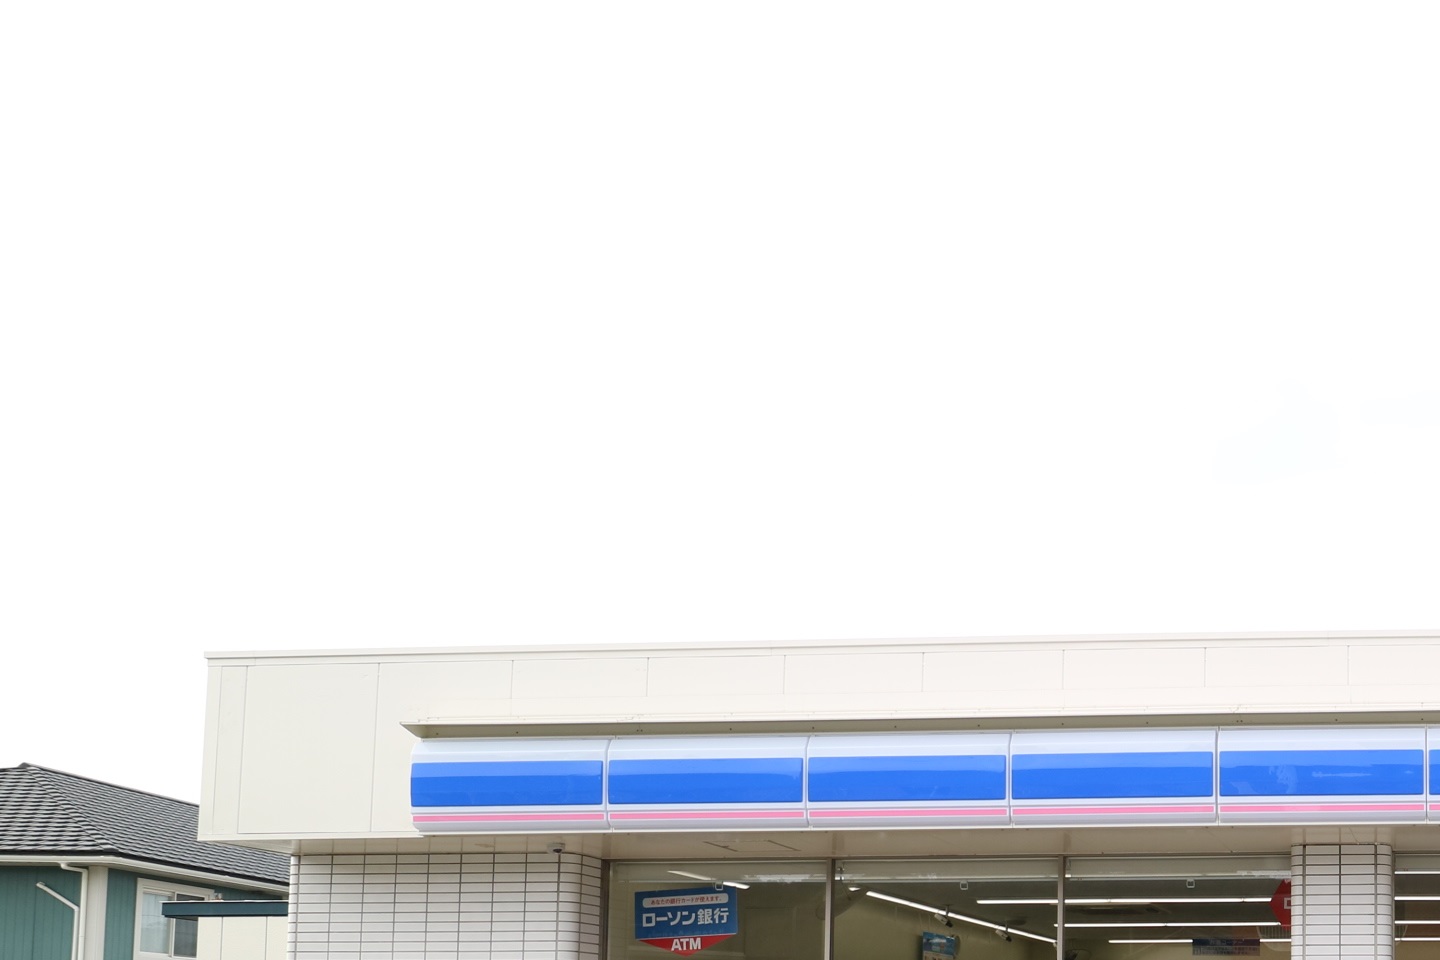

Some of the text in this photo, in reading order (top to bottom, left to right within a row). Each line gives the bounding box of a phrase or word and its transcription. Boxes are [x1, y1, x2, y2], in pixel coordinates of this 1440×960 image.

[642, 908, 729, 928] ローソン銀行
[671, 937, 701, 951] ATM
